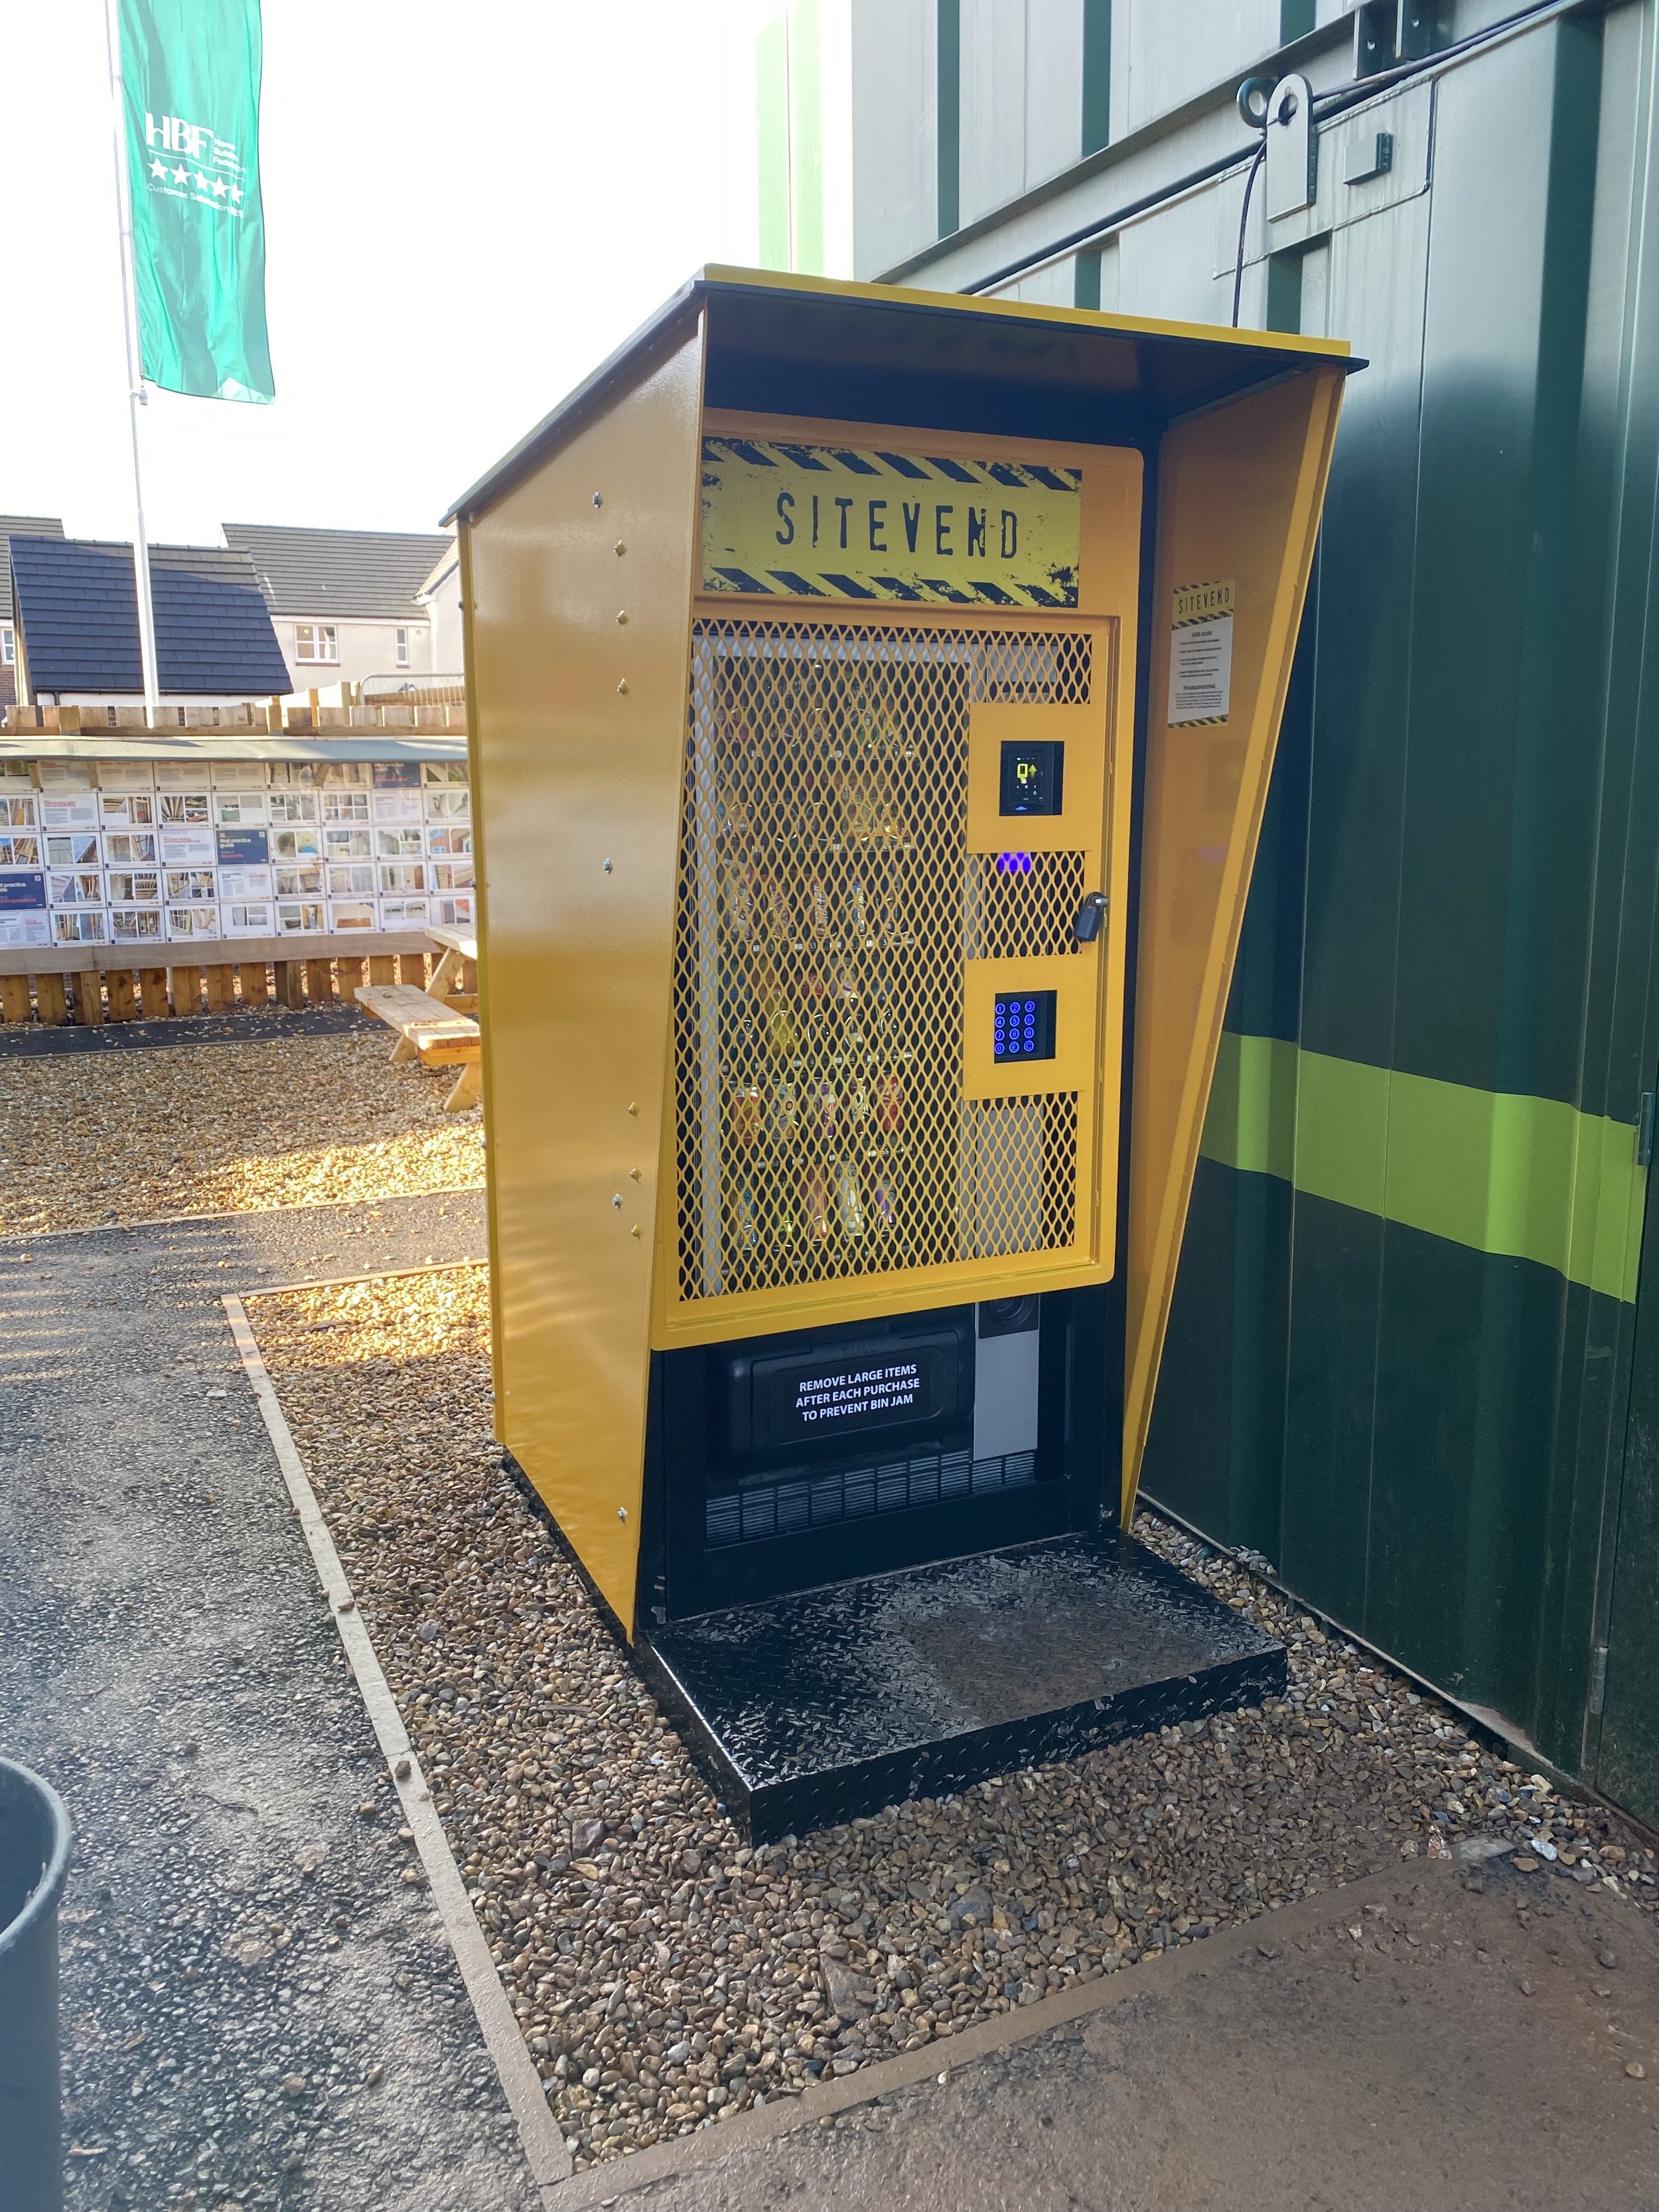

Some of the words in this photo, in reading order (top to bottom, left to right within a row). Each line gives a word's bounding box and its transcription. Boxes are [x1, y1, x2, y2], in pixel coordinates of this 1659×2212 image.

[145, 111, 214, 159] HBF
[776, 492, 1017, 559] SITEVEND
[1179, 587, 1230, 614] SITEVEND
[800, 1375, 846, 1392] REMOVE
[848, 1369, 883, 1384] LARGE
[885, 1364, 917, 1378] ITEMS
[796, 1394, 830, 1408] AFTER
[832, 1388, 861, 1402] EACH
[864, 1378, 920, 1396] PURCHASE
[802, 1410, 818, 1422] TO
[820, 1401, 869, 1419] PREVENT
[871, 1398, 889, 1410] BIN
[891, 1394, 913, 1407] JAM
